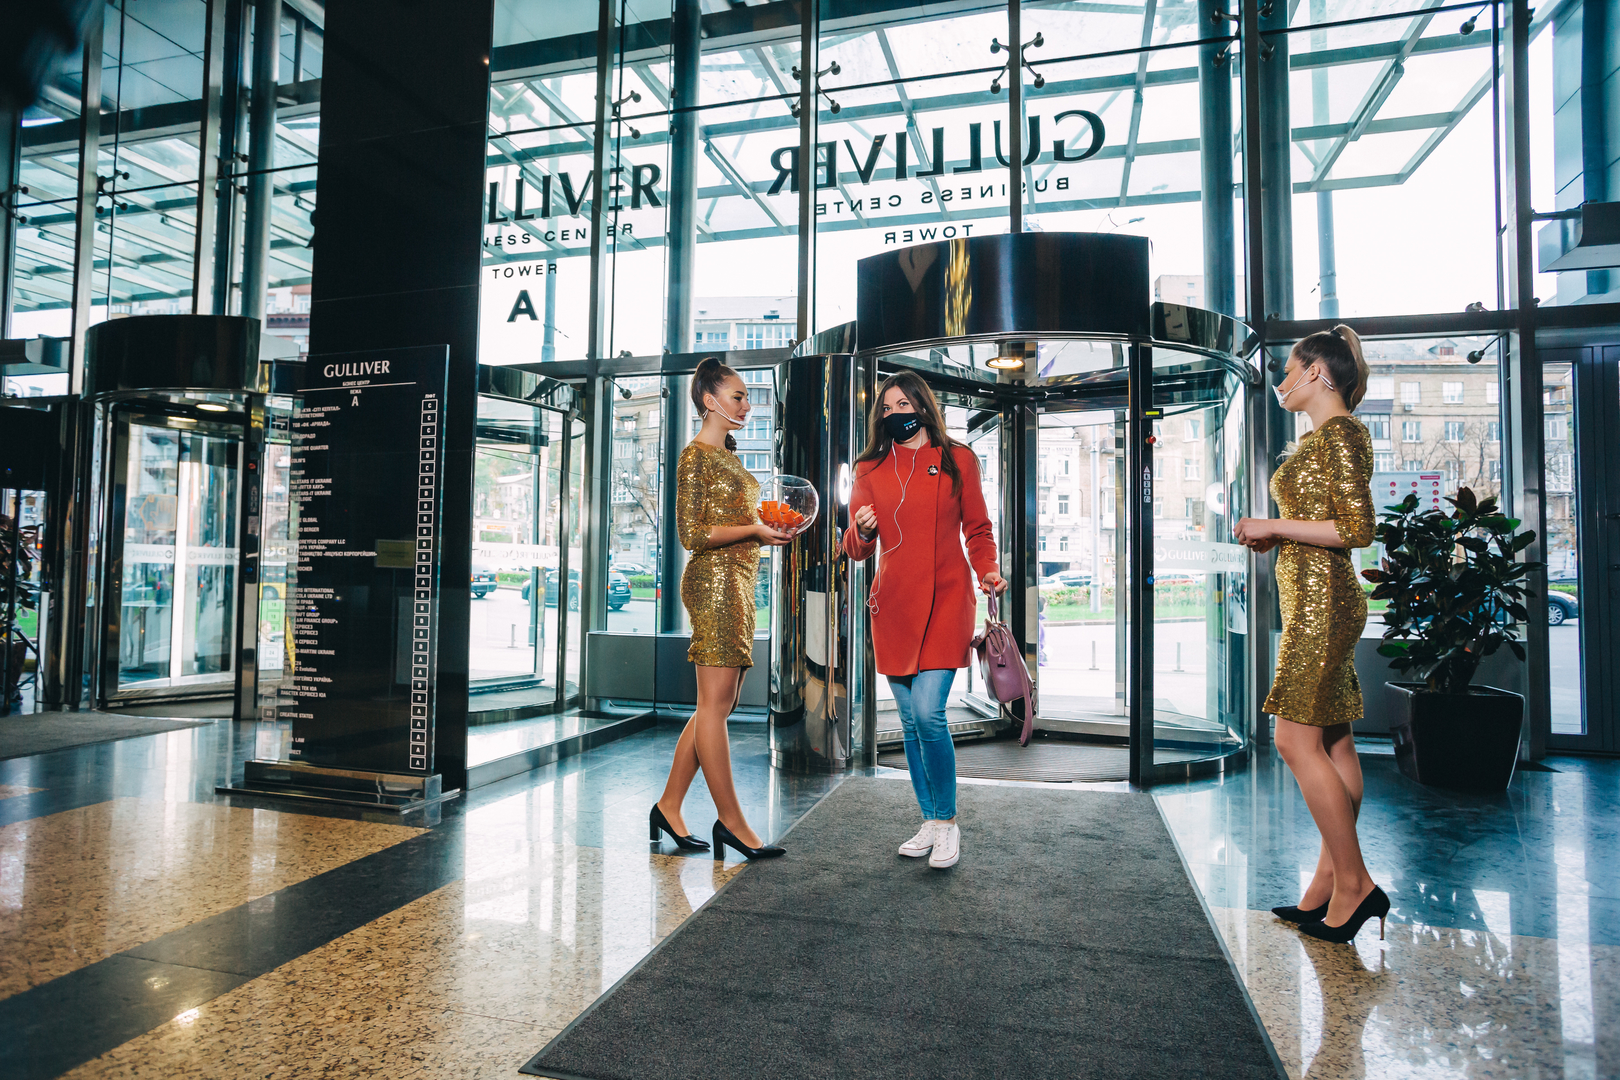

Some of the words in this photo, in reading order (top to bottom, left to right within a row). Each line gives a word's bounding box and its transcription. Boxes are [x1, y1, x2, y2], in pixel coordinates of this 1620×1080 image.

[544, 223, 633, 242] CENER
[492, 263, 558, 280] TOWER
[506, 289, 540, 323] A
[323, 360, 390, 378] GULLIVER
